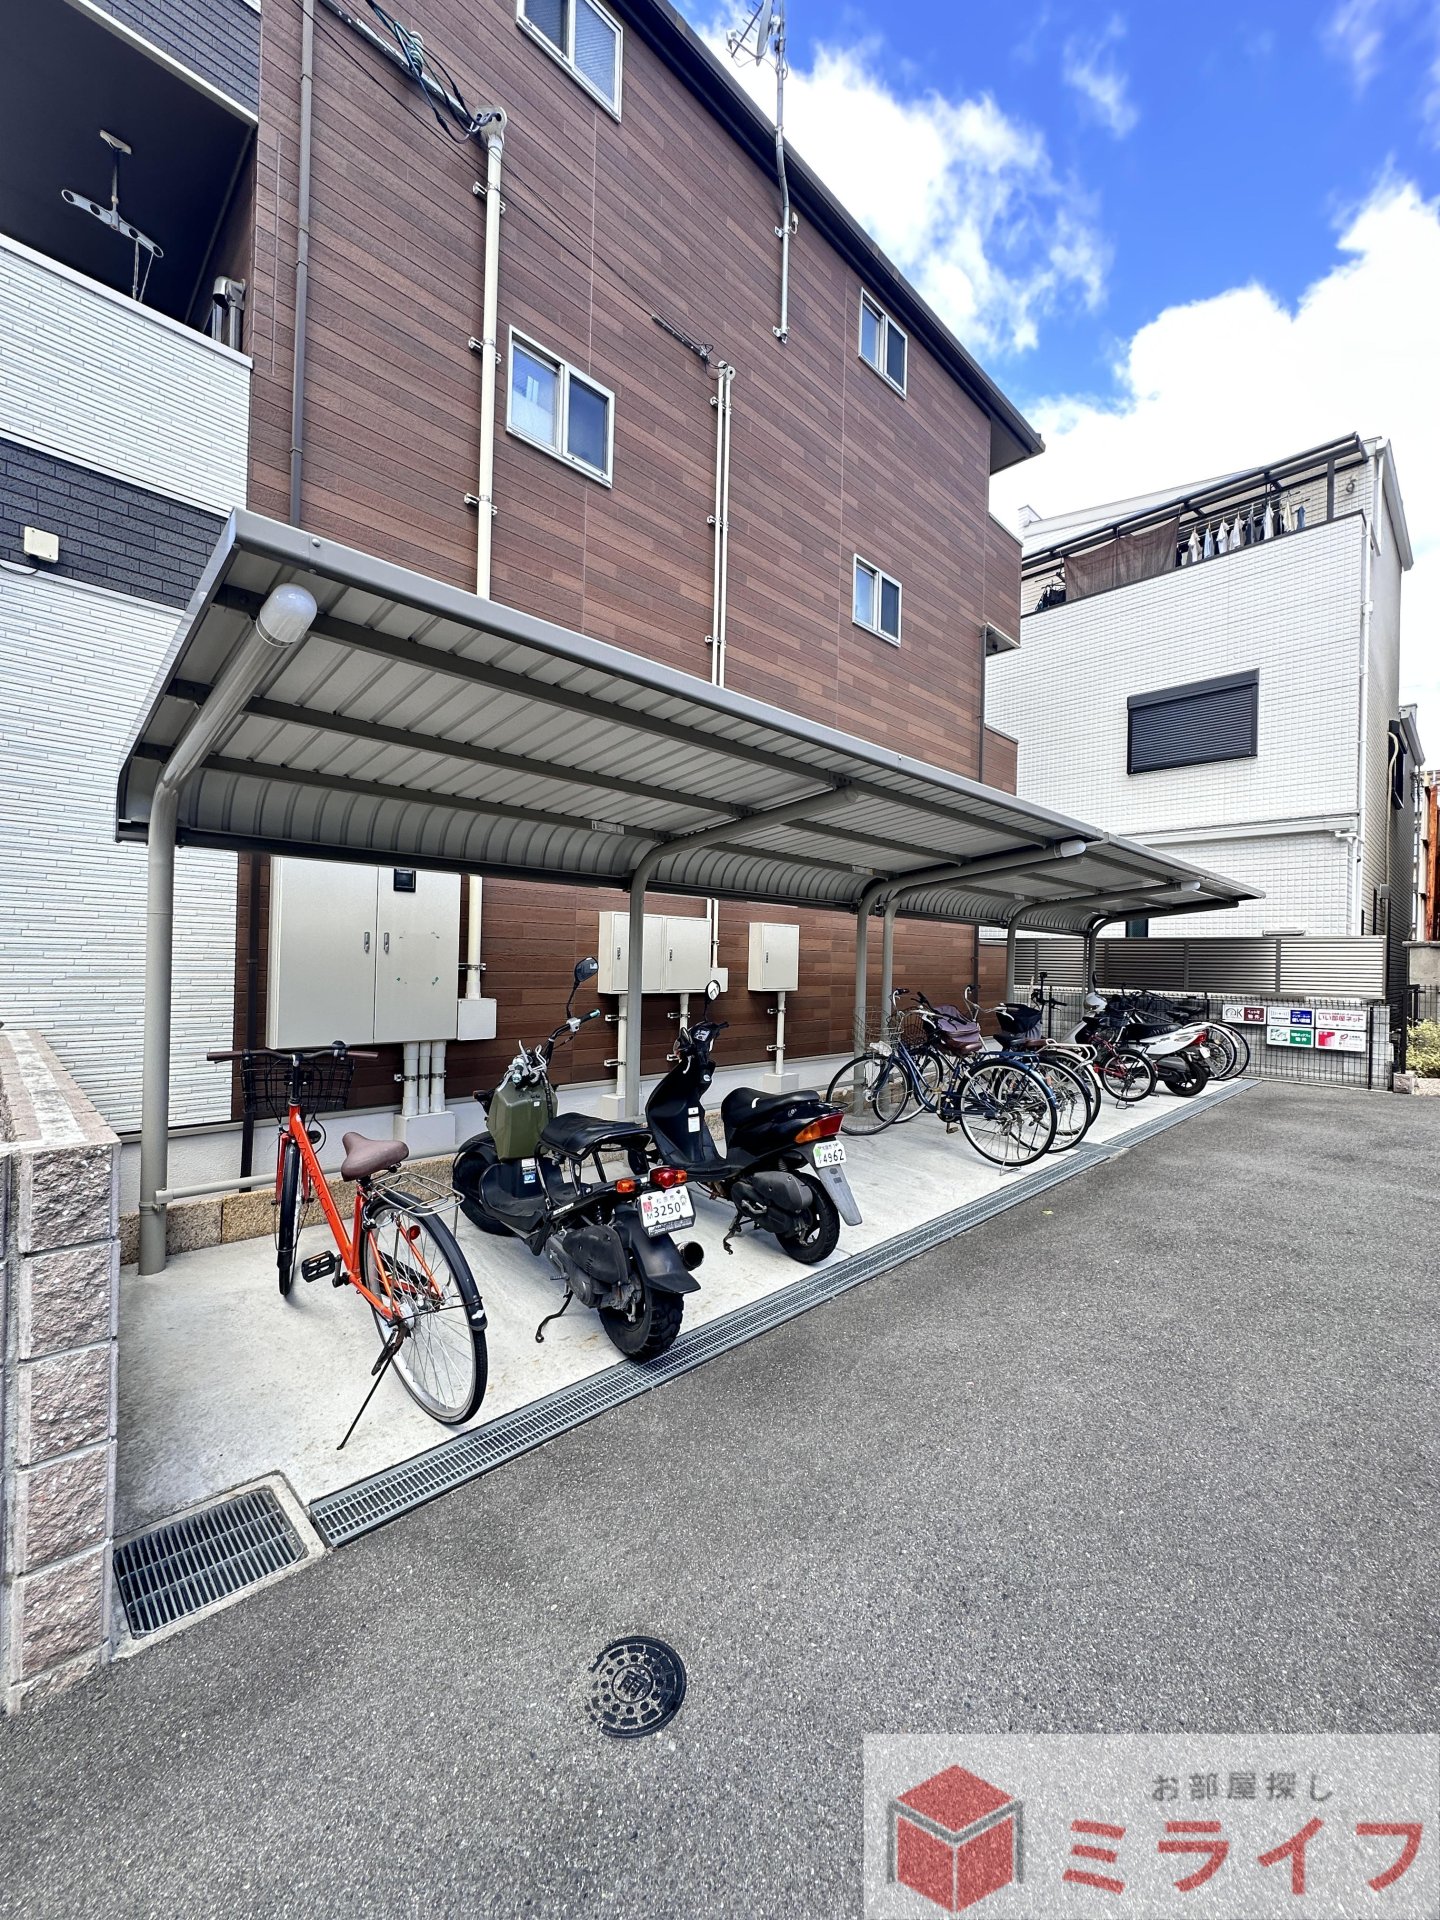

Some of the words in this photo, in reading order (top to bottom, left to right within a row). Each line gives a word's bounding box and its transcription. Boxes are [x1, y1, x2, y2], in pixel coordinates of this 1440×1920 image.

[1318, 1015, 1363, 1023] いい部屋ネット
[823, 1149, 845, 1163] 4962
[653, 1202, 681, 1218] 3250
